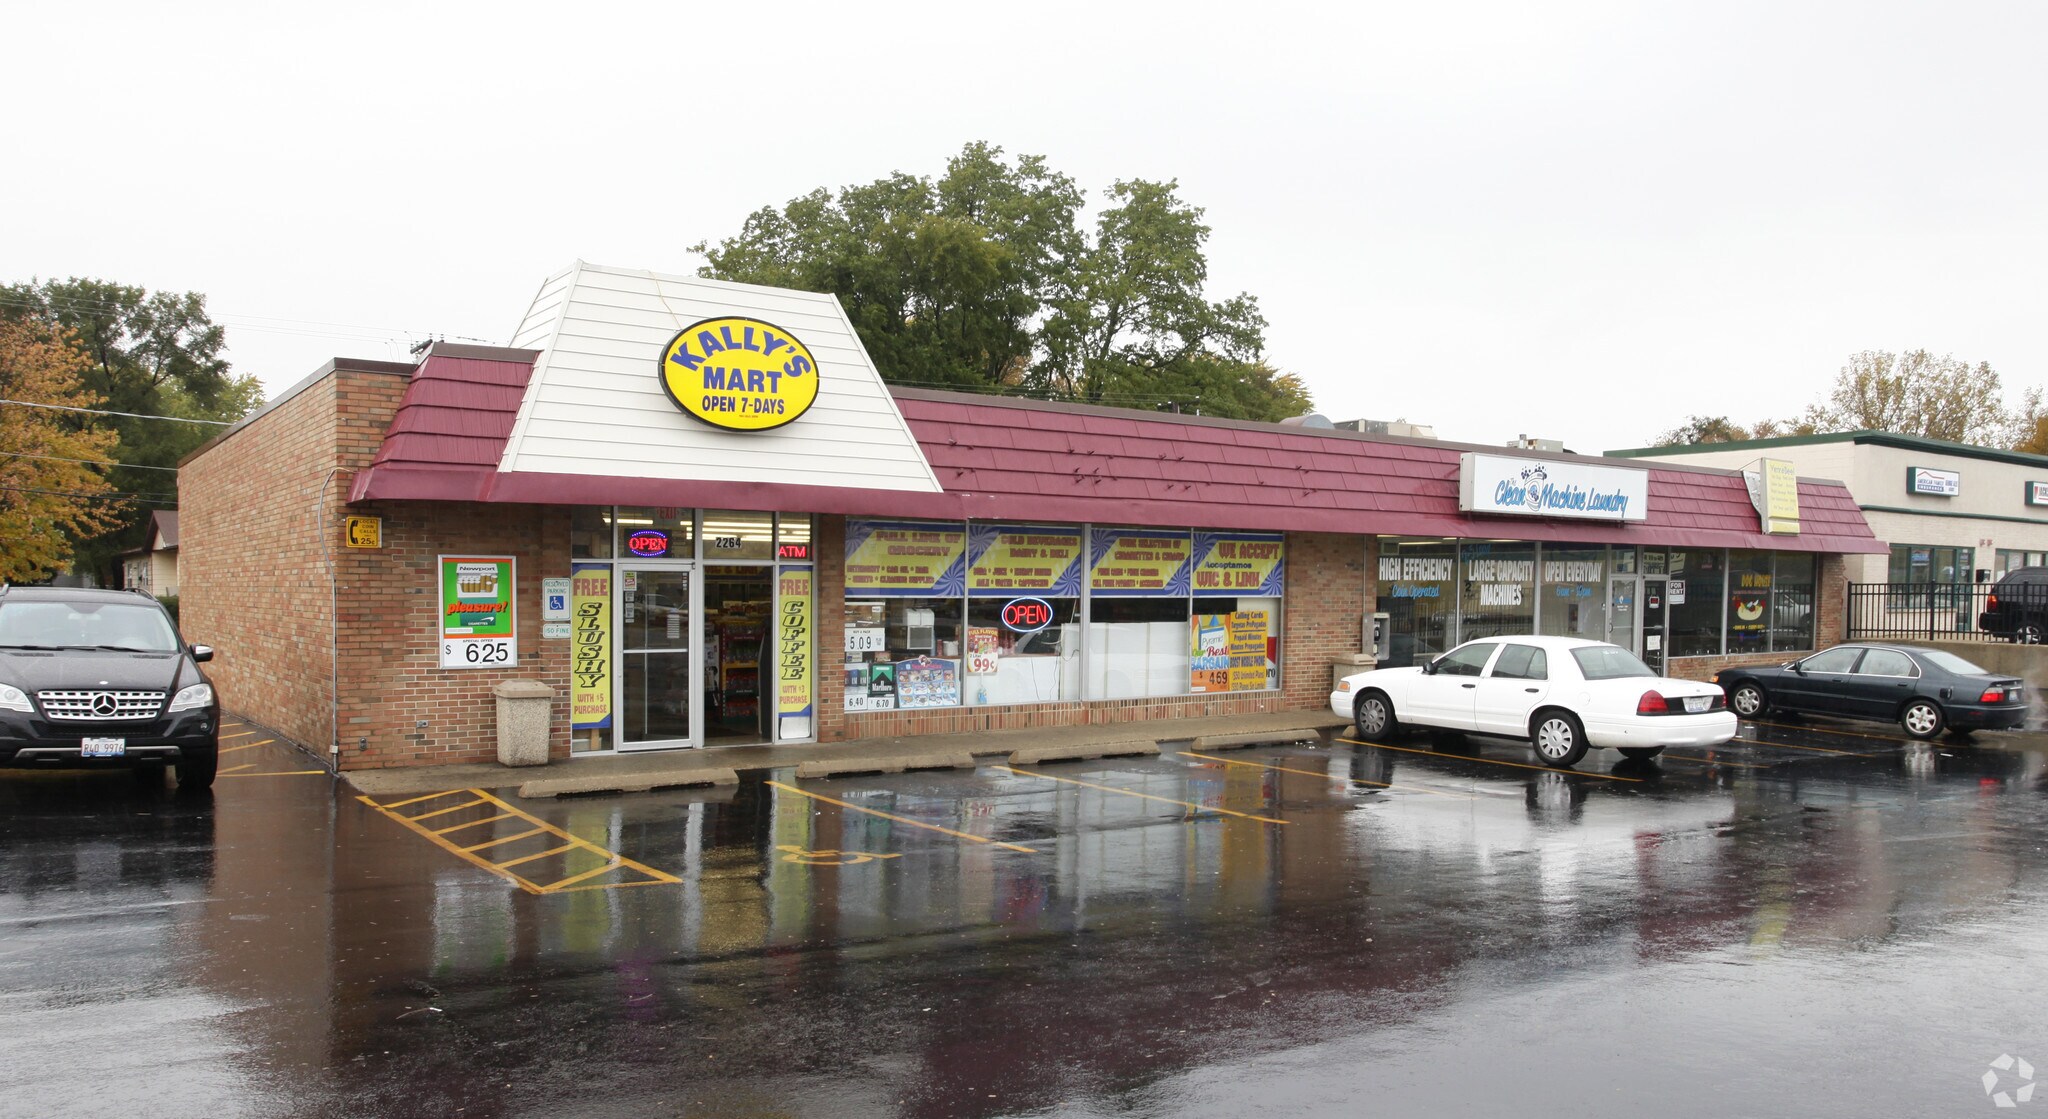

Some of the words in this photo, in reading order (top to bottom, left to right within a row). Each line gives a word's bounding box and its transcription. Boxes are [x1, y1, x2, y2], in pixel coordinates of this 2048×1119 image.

[670, 326, 811, 377] KALLY'S
[703, 366, 782, 394] MART
[702, 395, 736, 412] OPEN
[741, 397, 785, 415] 7-DAYS
[1494, 480, 1526, 507] Clean
[1538, 482, 1586, 511] Machine
[1586, 487, 1629, 518] Laundry
[628, 538, 668, 550] OPEN
[716, 537, 742, 548] 2264
[876, 532, 908, 542] FULL
[912, 532, 941, 543] LINE
[778, 546, 806, 558] ATM
[888, 545, 950, 556] GROCERY
[1040, 548, 1048, 558] &
[1218, 542, 1236, 560] WE
[1239, 542, 1280, 560] ACCEPT
[1204, 561, 1252, 570] Acceptamos
[1379, 558, 1400, 581] HIGH
[1403, 558, 1452, 582] EFFICIENCY
[1468, 560, 1495, 582] LARGE
[1497, 560, 1534, 582] CAPACITY
[1545, 561, 1565, 582] OPEN
[1566, 562, 1602, 582] EVERYDAY
[1196, 571, 1220, 588] WIC
[1223, 571, 1232, 588] &
[1235, 571, 1260, 588] LINK
[573, 578, 608, 596] FREE
[778, 578, 809, 596] FREE
[1392, 584, 1408, 598] Coin
[1408, 584, 1440, 600] Operated
[1480, 584, 1522, 606] MACHINES
[446, 600, 508, 616] pleasure!
[1004, 604, 1047, 625] OPEN
[1235, 612, 1250, 620] Calling
[782, 600, 805, 680] COFFEE
[980, 629, 998, 637] FLAVOR
[445, 644, 452, 655] $
[574, 602, 606, 688] SLUSHY
[850, 636, 872, 650] 5.09
[1207, 646, 1228, 657] Best
[1192, 656, 1230, 671] BARGAIN
[782, 684, 796, 694] WITH
[872, 681, 892, 692] Marlboro
[577, 694, 594, 702] WITH
[778, 695, 808, 705] PURCHASE
[848, 698, 864, 707] 6.40
[876, 700, 890, 708] 6.70
[574, 704, 608, 714] PURCHASE
